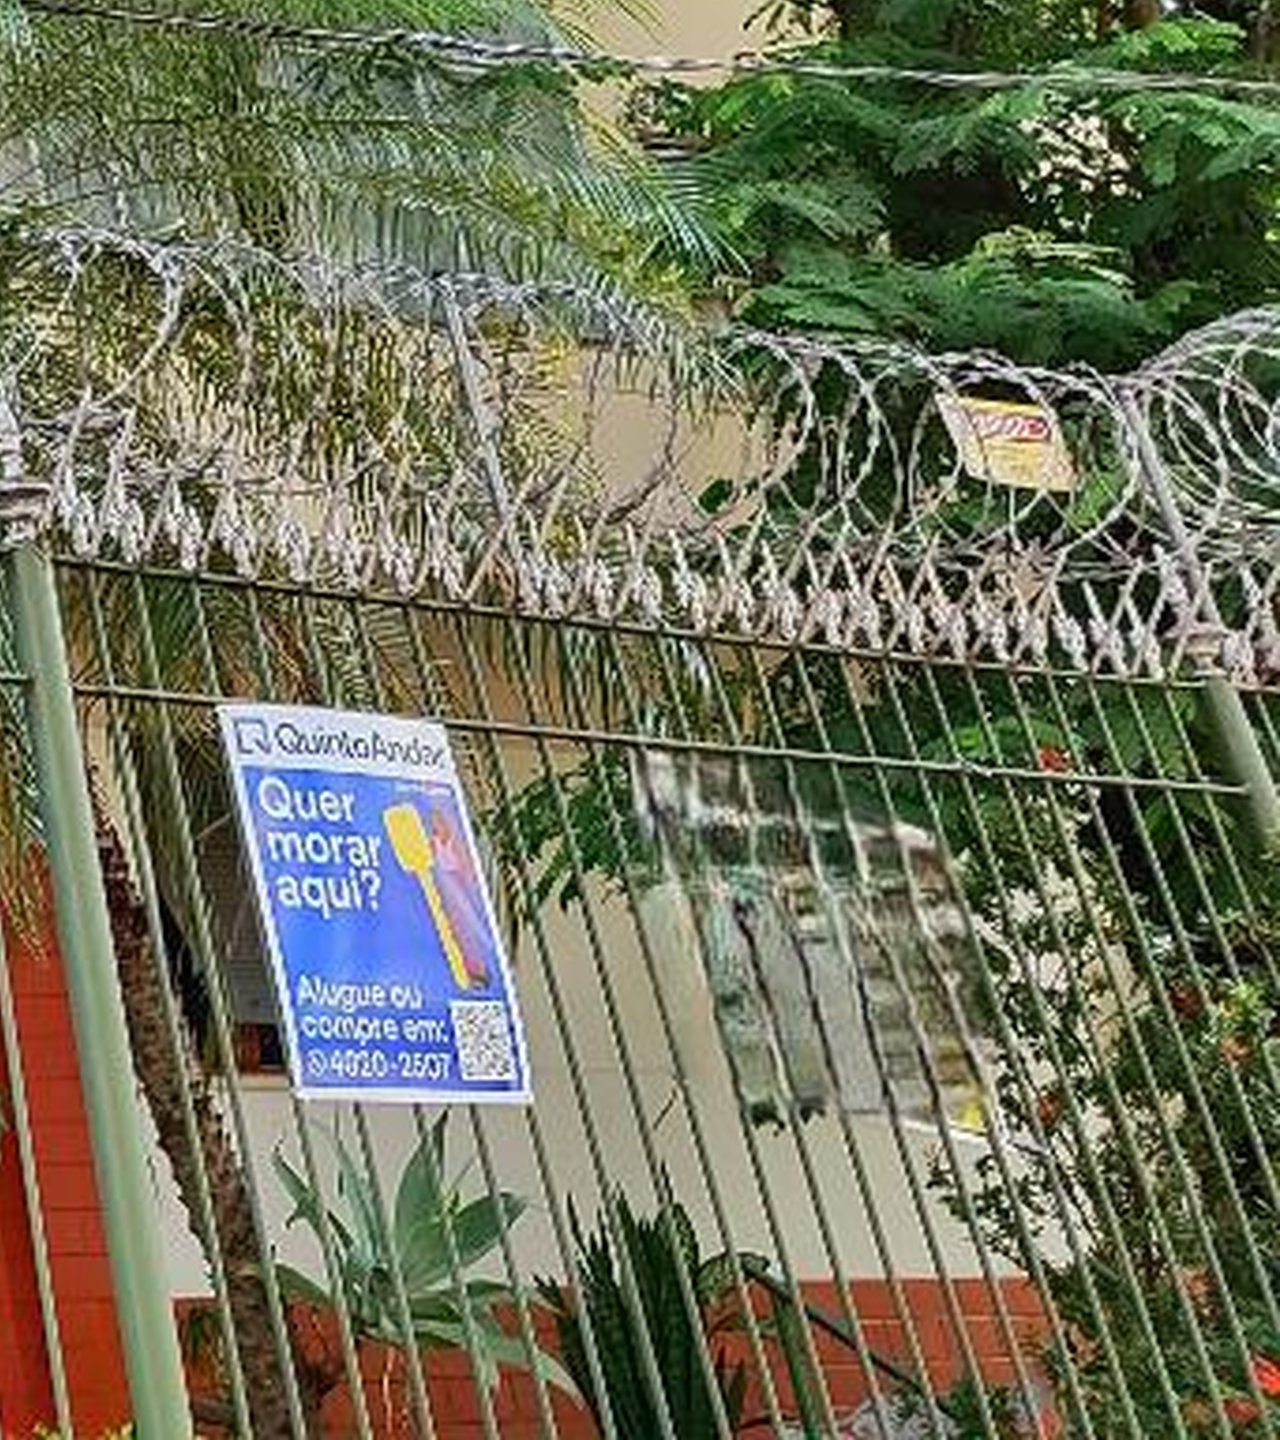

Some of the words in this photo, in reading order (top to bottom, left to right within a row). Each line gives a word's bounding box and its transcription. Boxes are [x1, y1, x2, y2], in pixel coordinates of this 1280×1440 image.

[258, 777, 354, 822] Quer
[267, 830, 381, 866] morar
[277, 869, 381, 919] aqui?
[297, 974, 386, 1012] Alugue
[391, 984, 423, 1009] ou
[300, 1015, 399, 1046] compre
